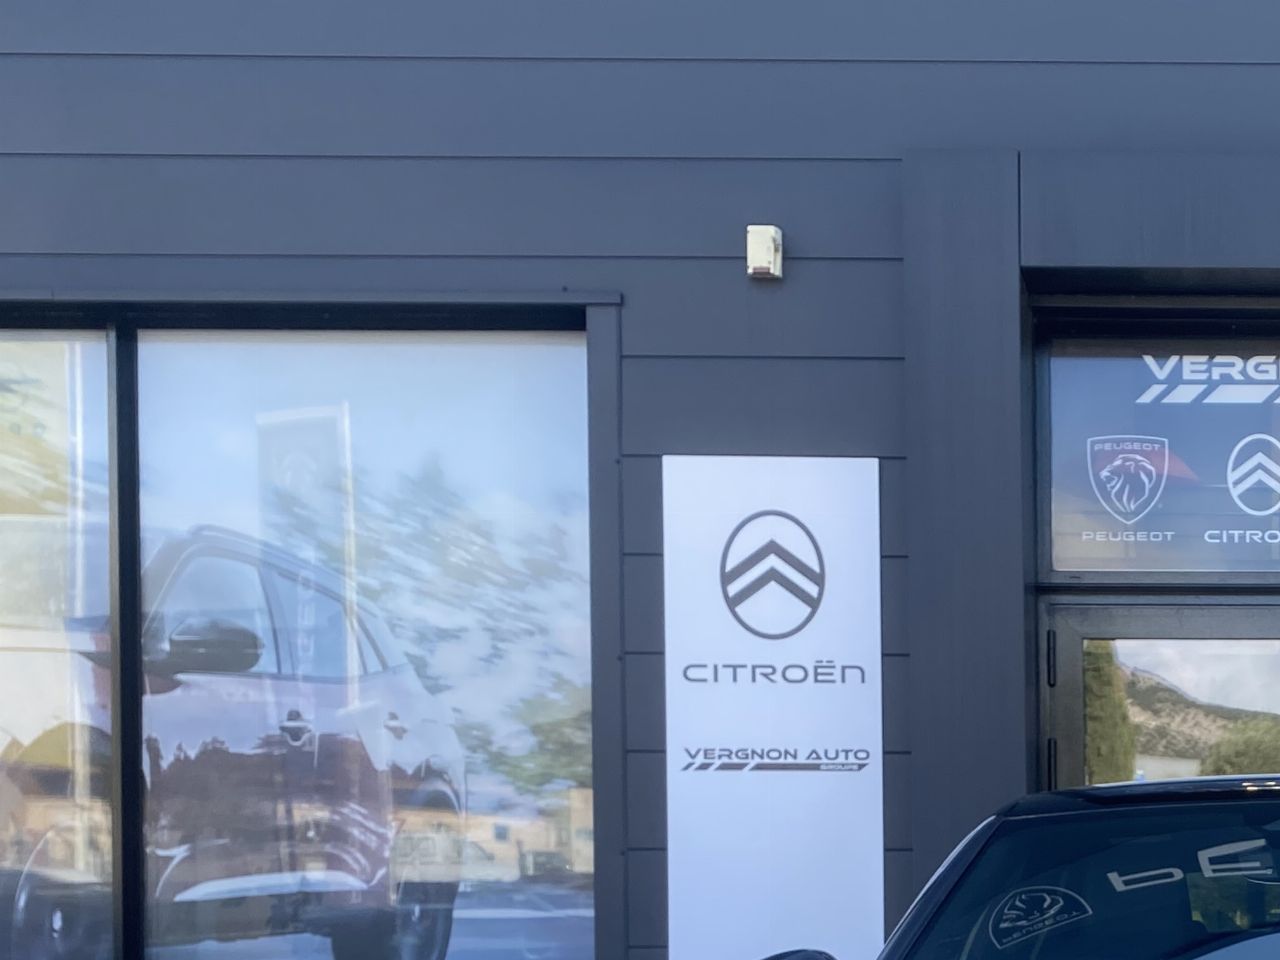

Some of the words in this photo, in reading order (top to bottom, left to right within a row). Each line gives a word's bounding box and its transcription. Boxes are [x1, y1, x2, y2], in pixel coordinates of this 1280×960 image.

[1093, 440, 1161, 452] PEUGEOT
[1081, 530, 1176, 542] PEUGEOT
[682, 659, 866, 684] CITROËN
[683, 747, 798, 761] VERGNON
[805, 748, 870, 761] AUTO
